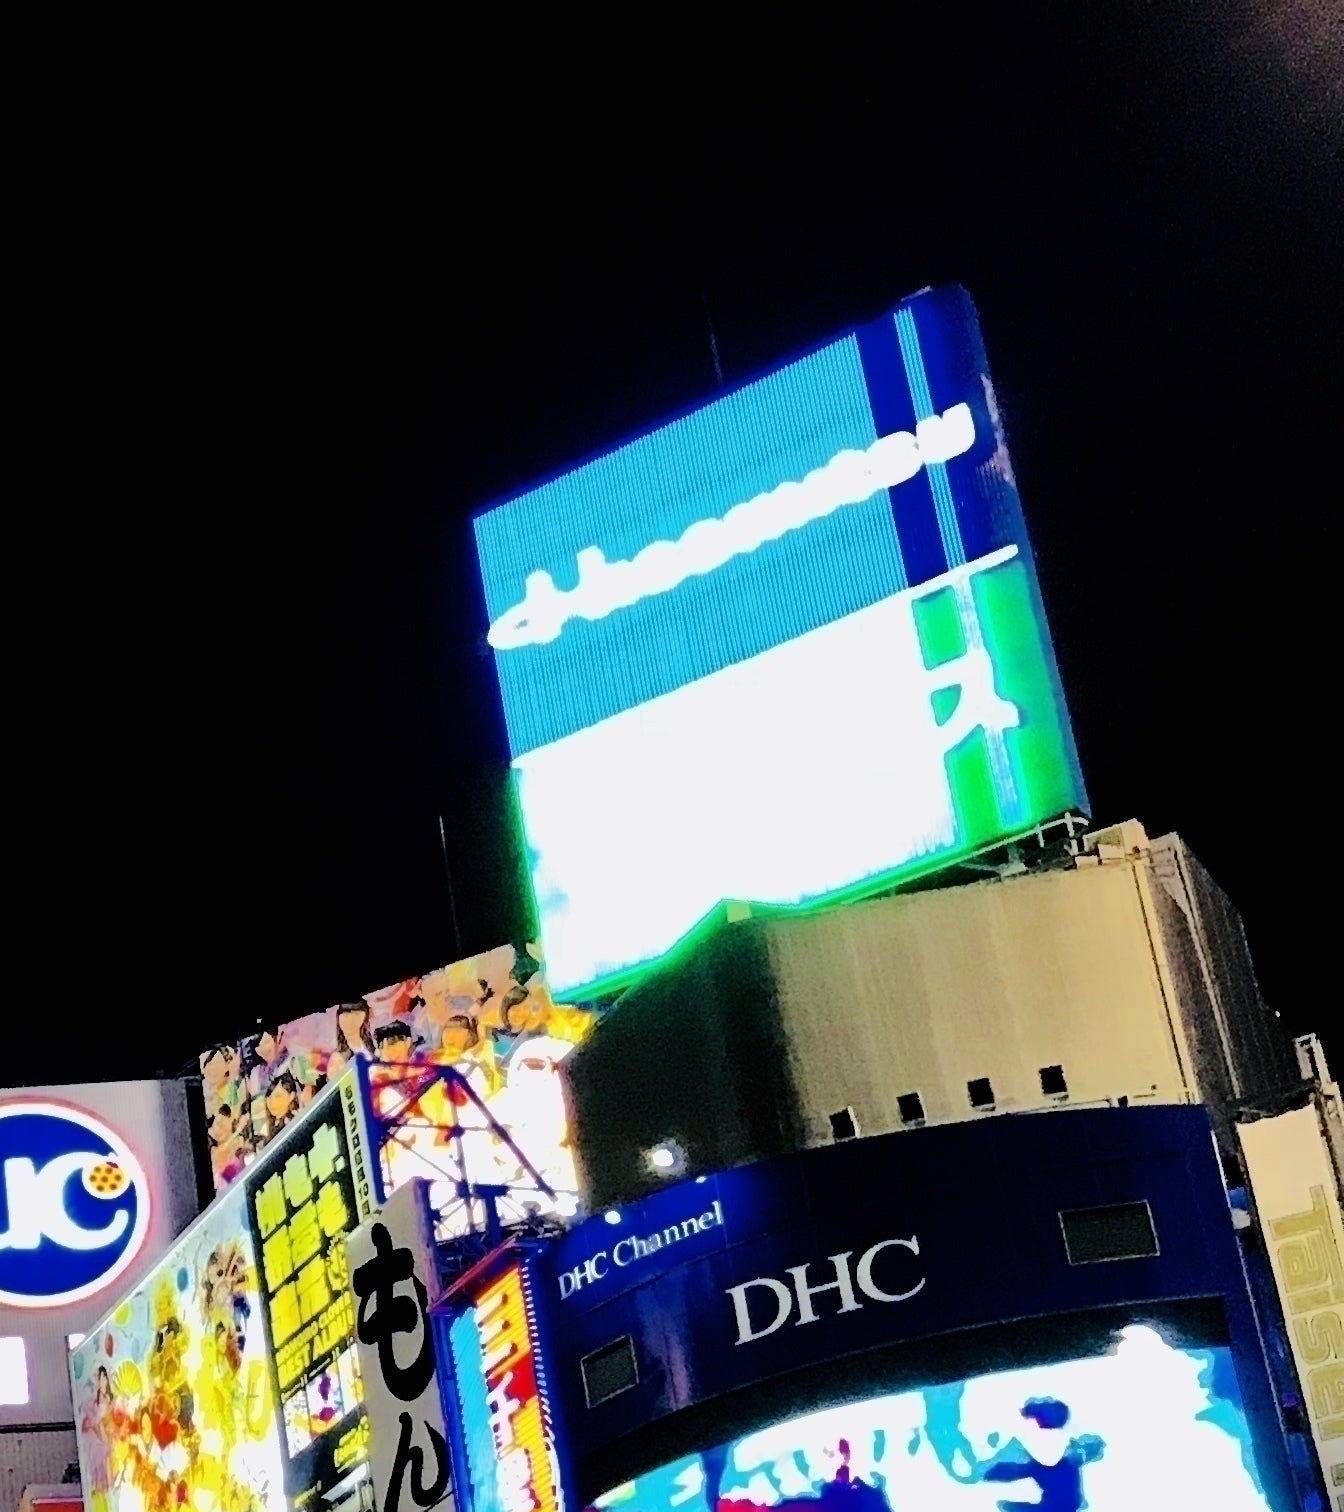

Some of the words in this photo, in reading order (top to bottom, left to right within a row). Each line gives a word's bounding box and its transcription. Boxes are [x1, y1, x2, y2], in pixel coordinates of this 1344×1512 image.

[558, 1250, 608, 1300] DHC
[612, 1200, 723, 1268] Channel
[724, 1235, 927, 1346] DHC
